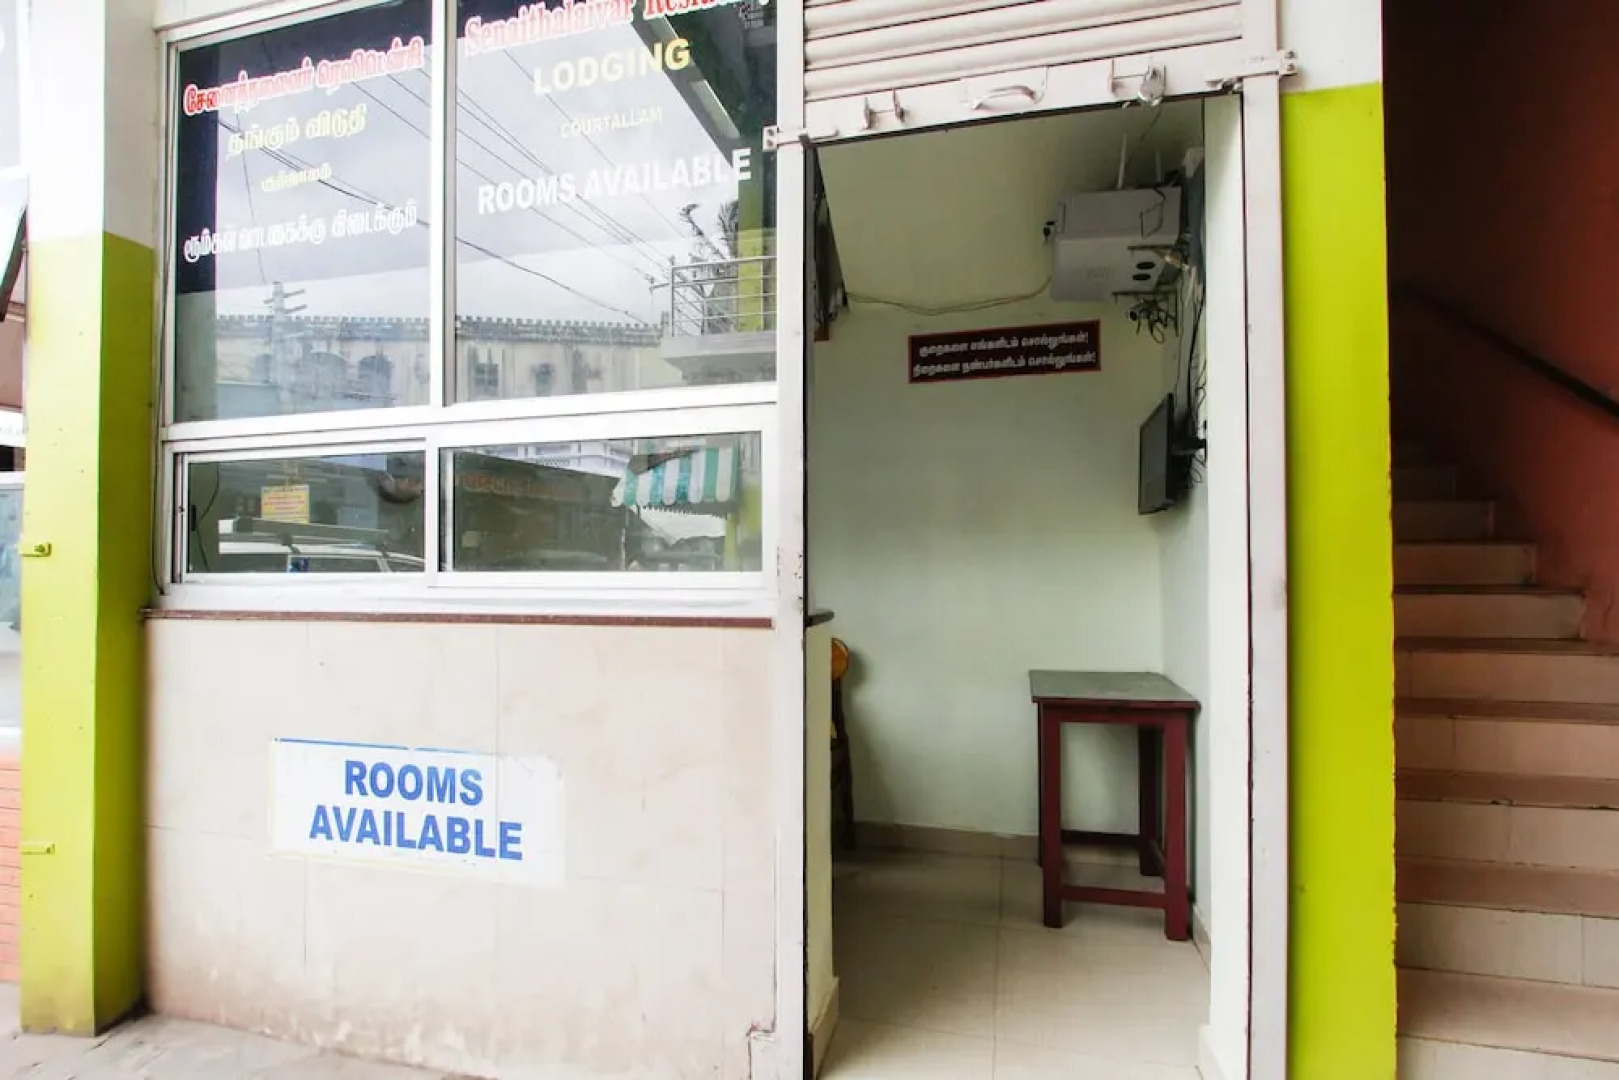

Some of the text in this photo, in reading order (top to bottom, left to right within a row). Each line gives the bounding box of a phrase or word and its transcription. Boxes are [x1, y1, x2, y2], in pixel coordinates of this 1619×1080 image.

[533, 38, 691, 95] LODGING
[225, 104, 367, 162] தங்கும் விடுதி
[560, 105, 663, 138] COURTALLAM
[477, 148, 752, 215] ROOMS AVAILABLE
[332, 198, 417, 238] கிடைக்கும்
[344, 759, 483, 806] ROOMS
[309, 804, 523, 861] AVAILABLE
